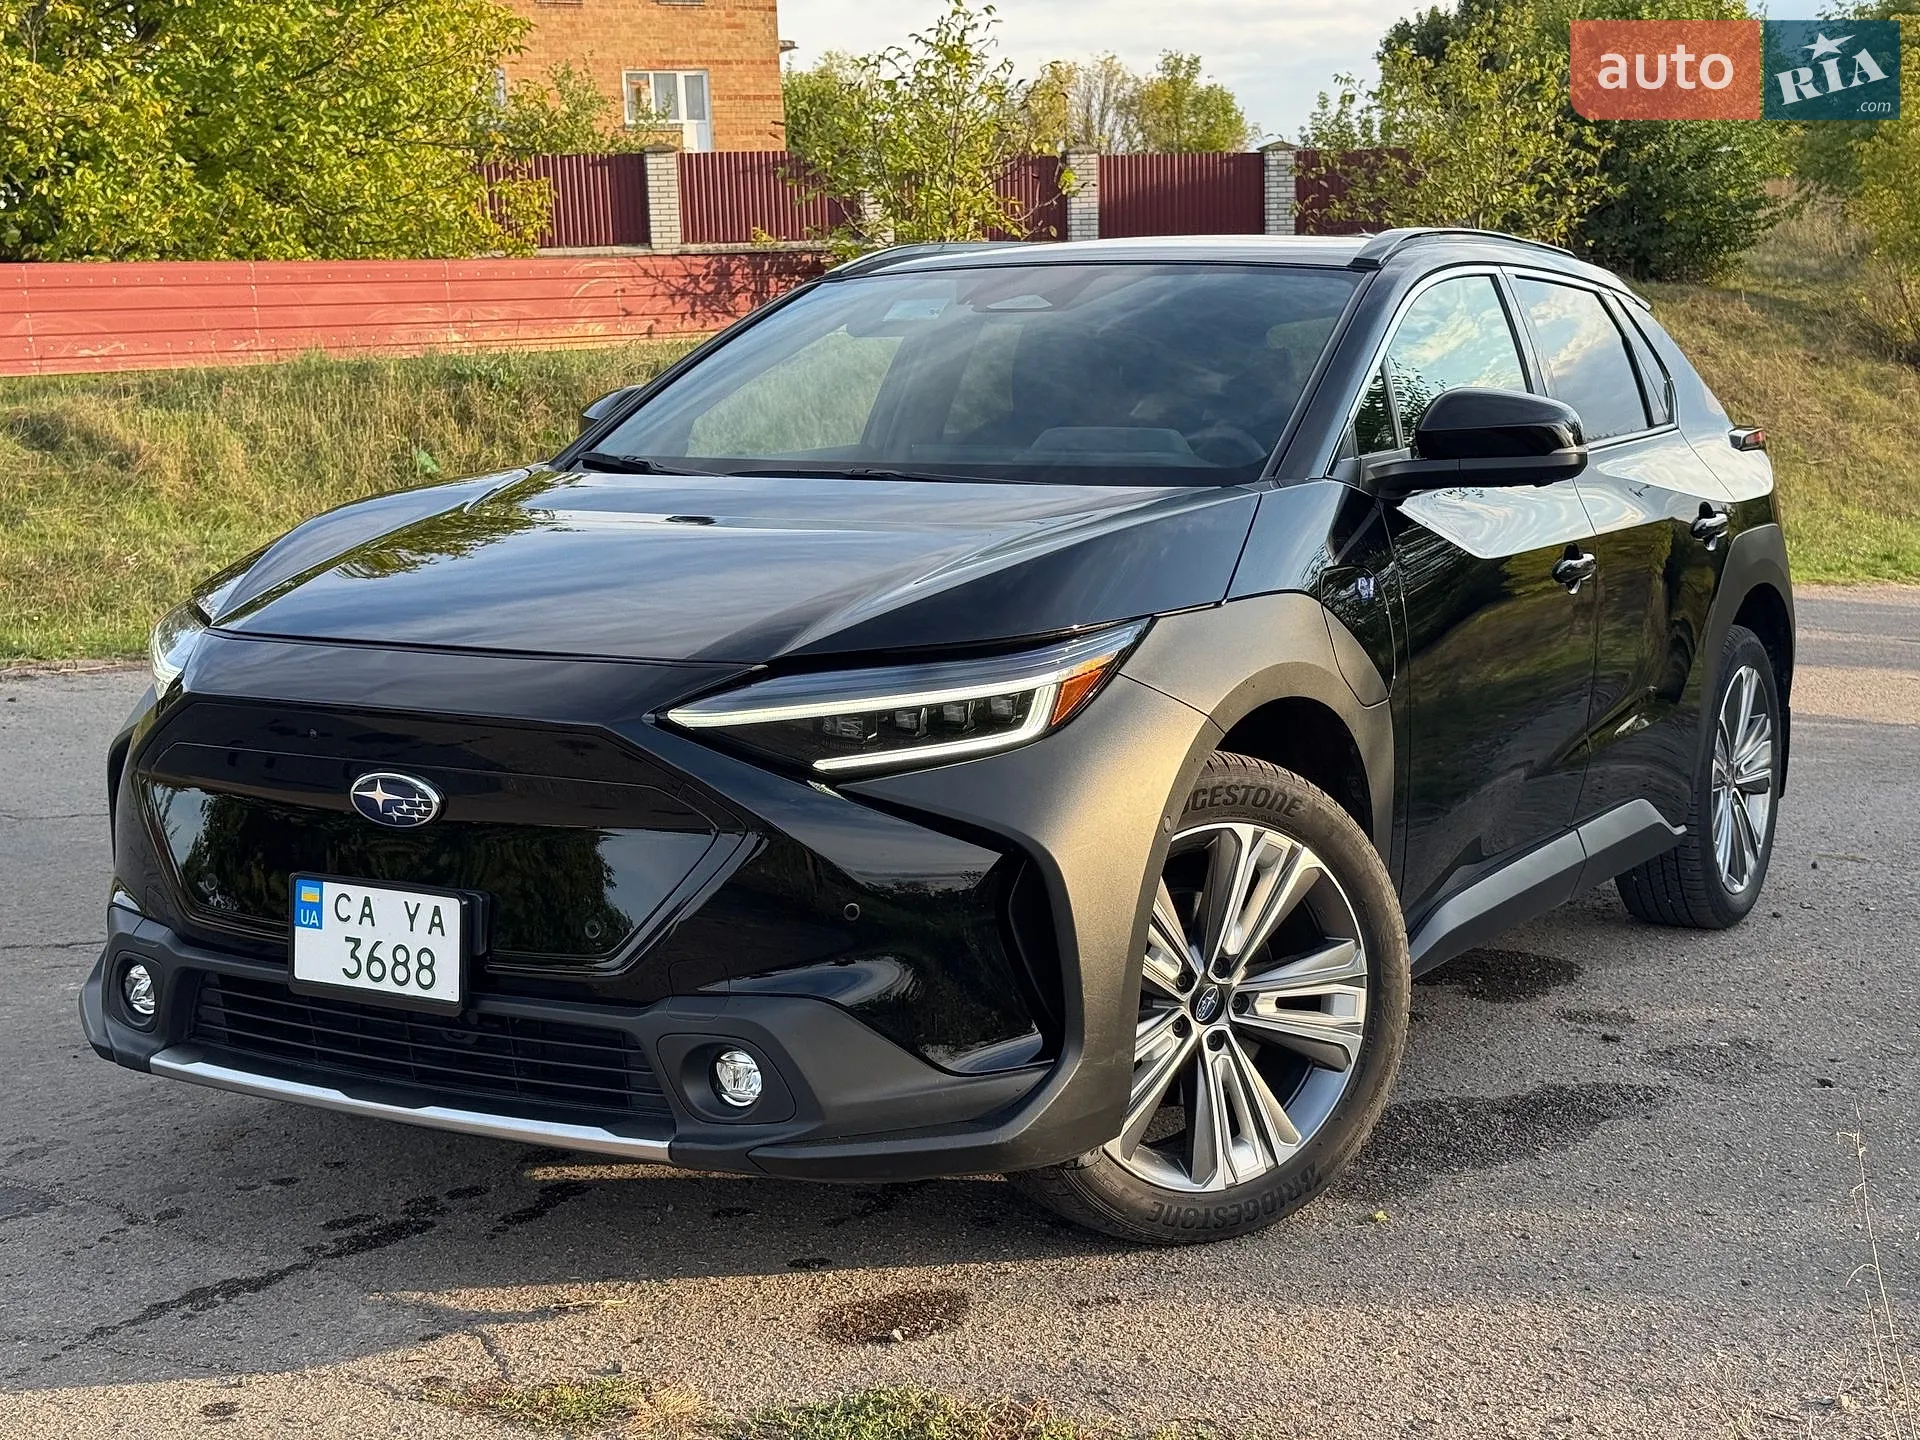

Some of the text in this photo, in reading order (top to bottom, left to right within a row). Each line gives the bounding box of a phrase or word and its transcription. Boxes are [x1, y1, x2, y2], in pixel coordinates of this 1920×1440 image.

[300, 909, 319, 927] UA
[334, 893, 446, 937] CA YA
[342, 936, 437, 990] 3688
[1145, 1160, 1323, 1230] BRIDGESTONE
